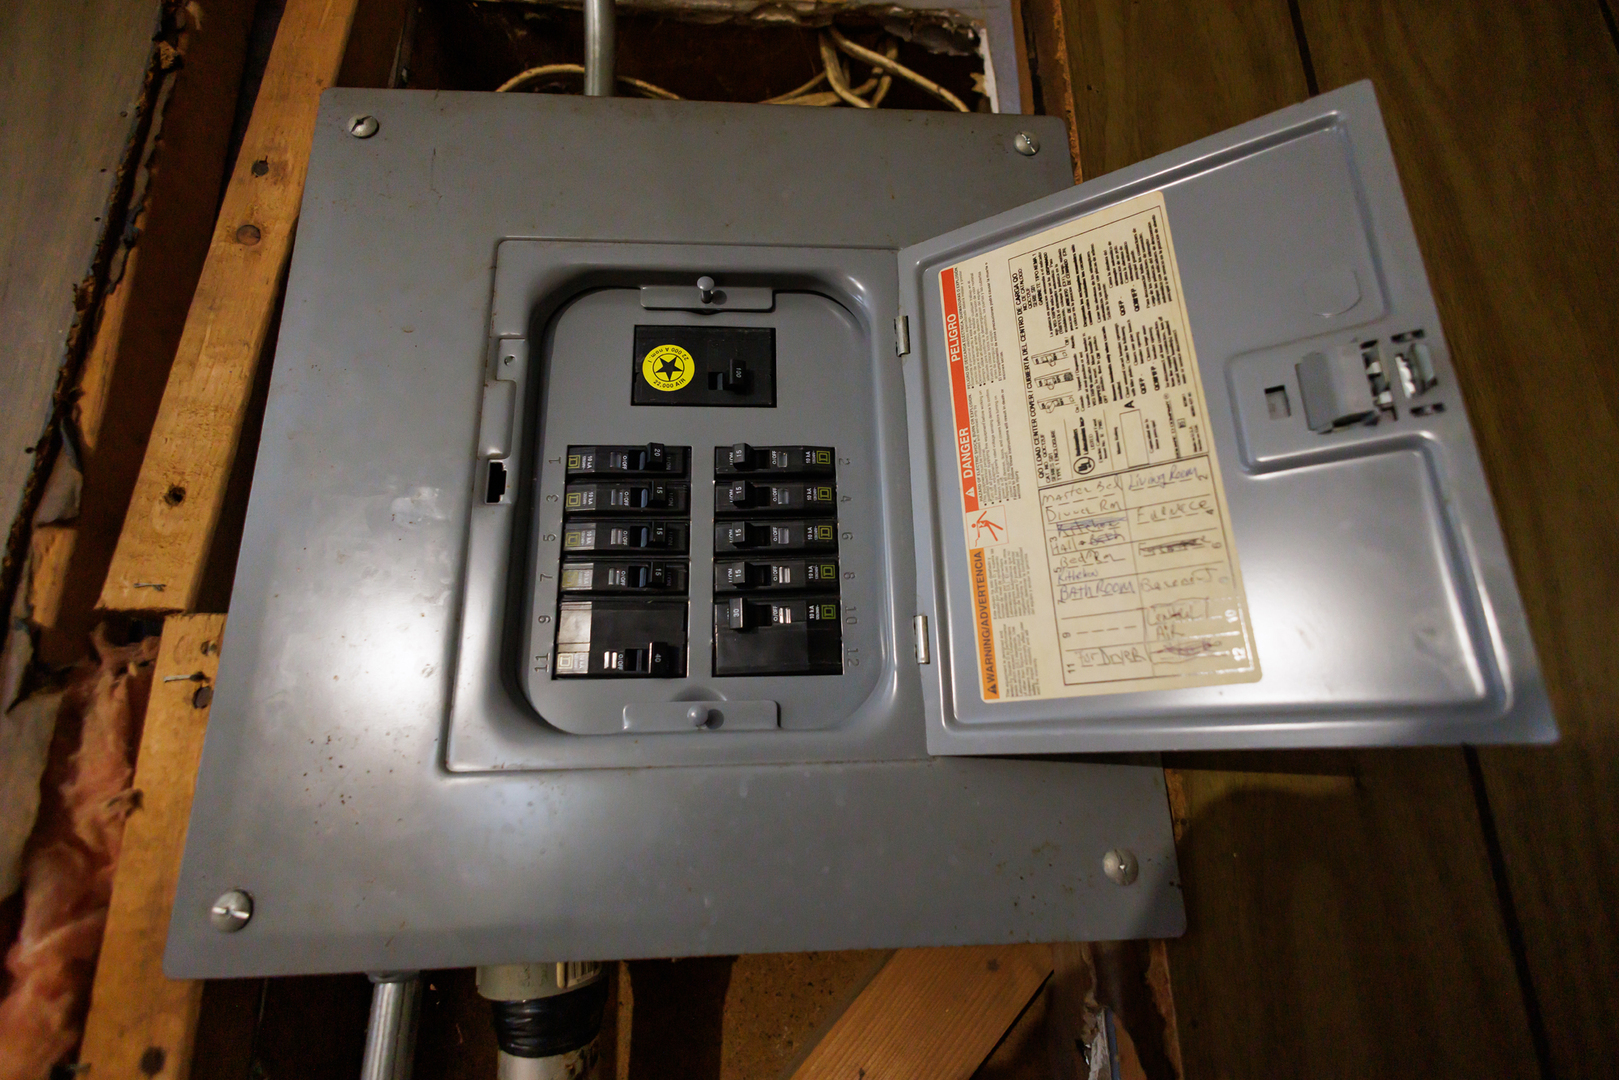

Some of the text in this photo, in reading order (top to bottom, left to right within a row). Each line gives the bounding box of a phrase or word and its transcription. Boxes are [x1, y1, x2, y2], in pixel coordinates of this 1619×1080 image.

[1012, 272, 1018, 283] QO
[1018, 316, 1026, 342] CENTRO
[947, 314, 960, 362] PELIGRO
[1023, 356, 1032, 389] CUBIERTA
[1124, 400, 1134, 408] A
[1031, 418, 1039, 445] CENTER
[654, 448, 660, 456] 20
[959, 427, 973, 478] DANGER
[1037, 467, 1044, 478] QO
[842, 532, 853, 540] 6
[540, 574, 552, 582] 7
[733, 608, 739, 618] 30
[845, 606, 857, 625] 10
[974, 551, 995, 683] WARNING/ADVERTENCIA
[1225, 609, 1238, 623] 10
[655, 653, 661, 662] 40
[847, 648, 859, 667] 12
[1232, 648, 1246, 661] 12
[534, 652, 549, 672] 11
[1067, 664, 1075, 673] 11
